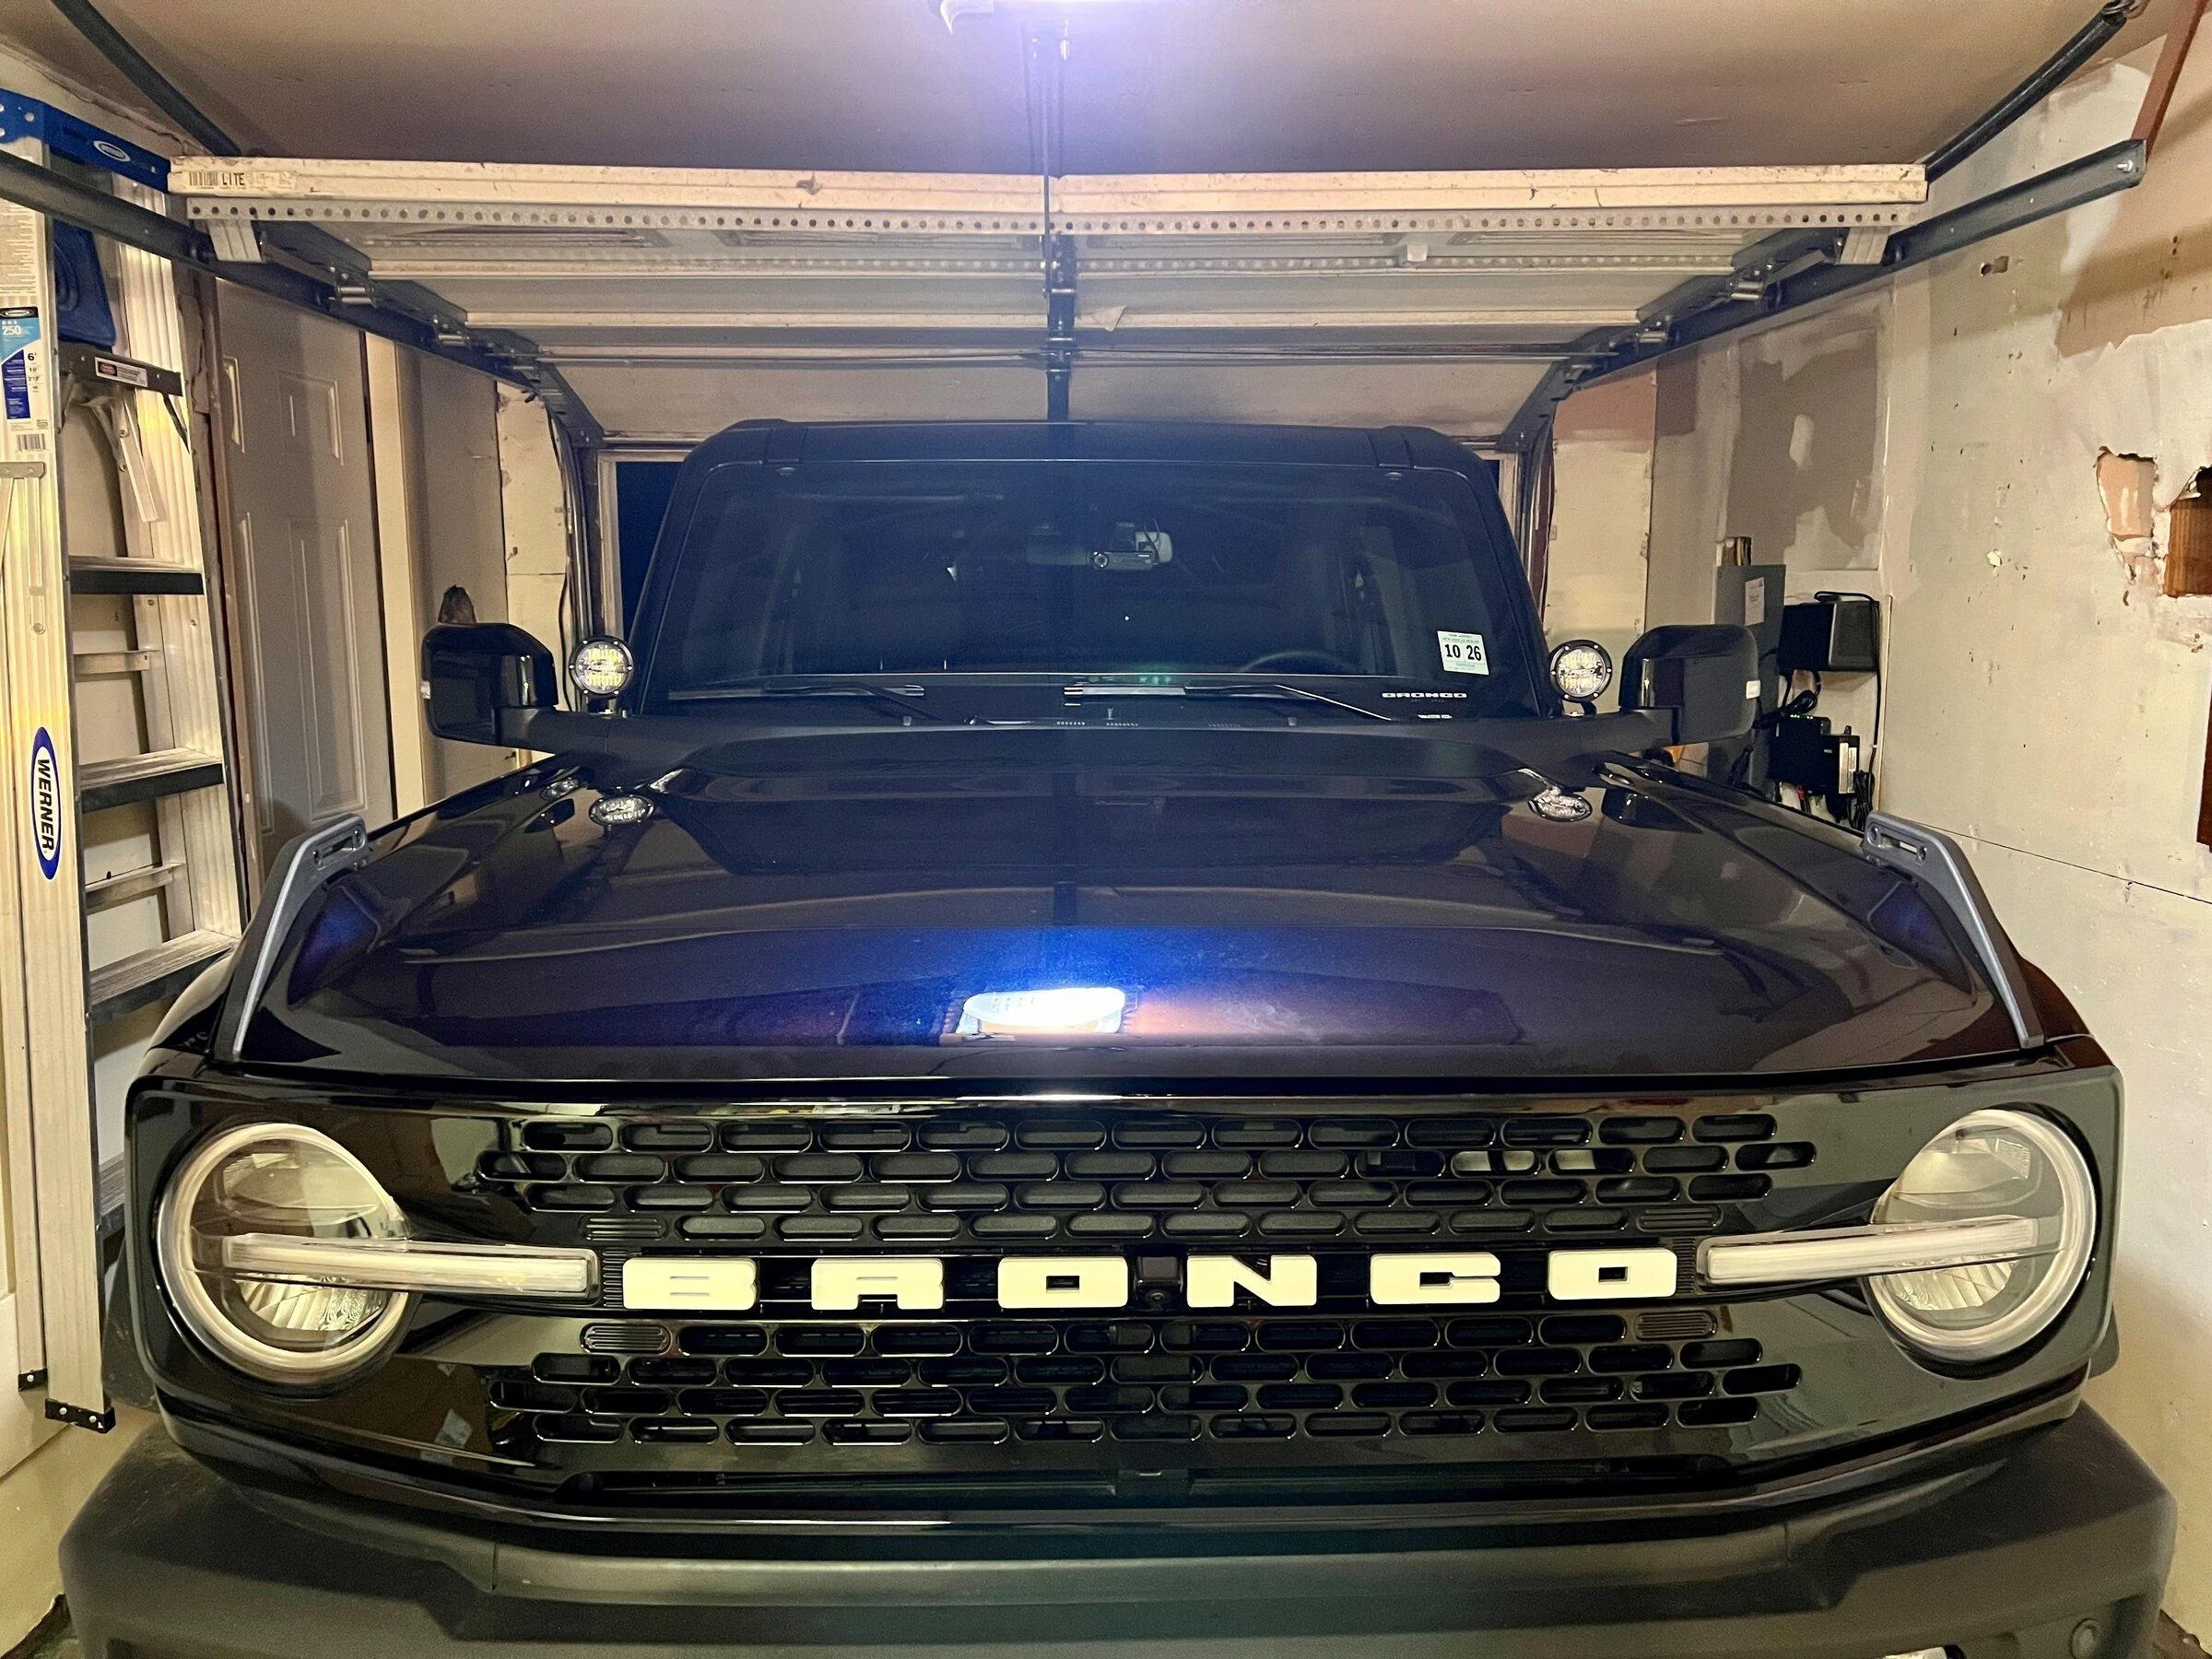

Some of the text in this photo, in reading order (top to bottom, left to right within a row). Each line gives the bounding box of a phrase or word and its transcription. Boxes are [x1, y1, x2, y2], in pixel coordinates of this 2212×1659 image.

[222, 172, 245, 185] LITE
[2, 324, 21, 335] 250
[1445, 643, 1482, 661] 10 26
[37, 759, 54, 851] WERNER
[622, 1247, 1678, 1311] BRONCO
